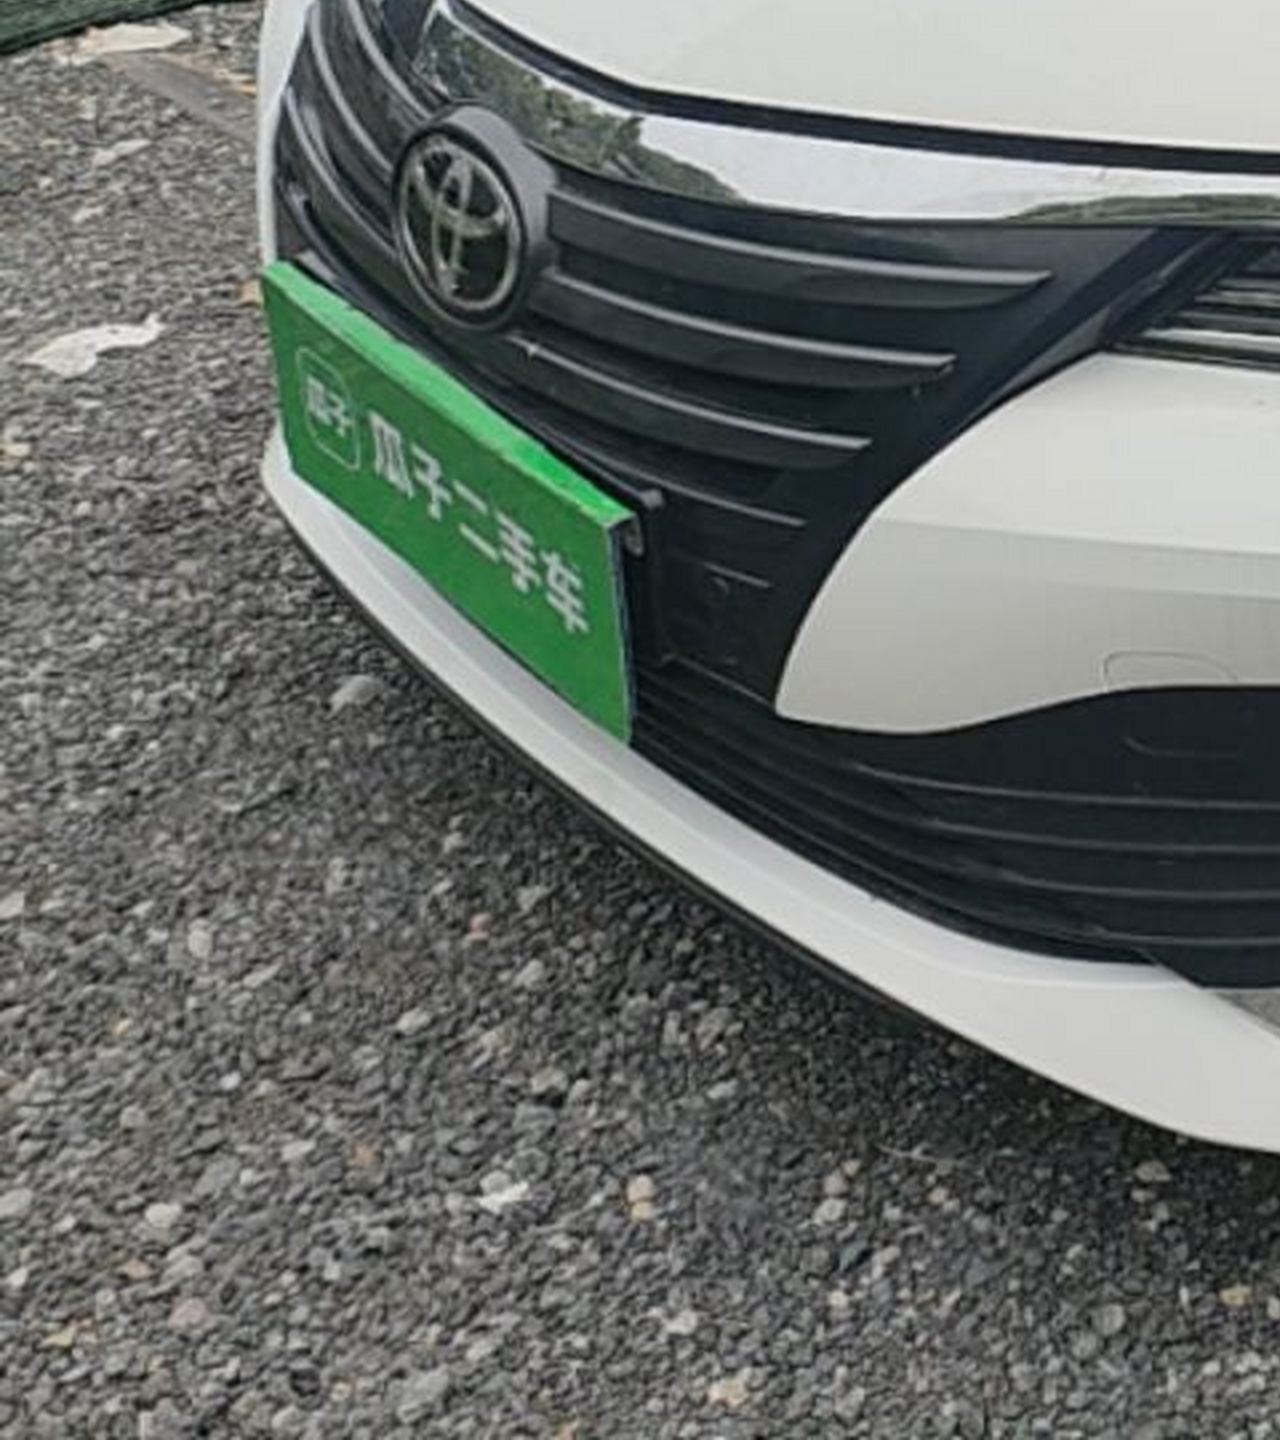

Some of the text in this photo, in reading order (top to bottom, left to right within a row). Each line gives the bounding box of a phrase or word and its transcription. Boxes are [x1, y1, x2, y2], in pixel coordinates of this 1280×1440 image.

[368, 409, 589, 636] 瓜子二手车
